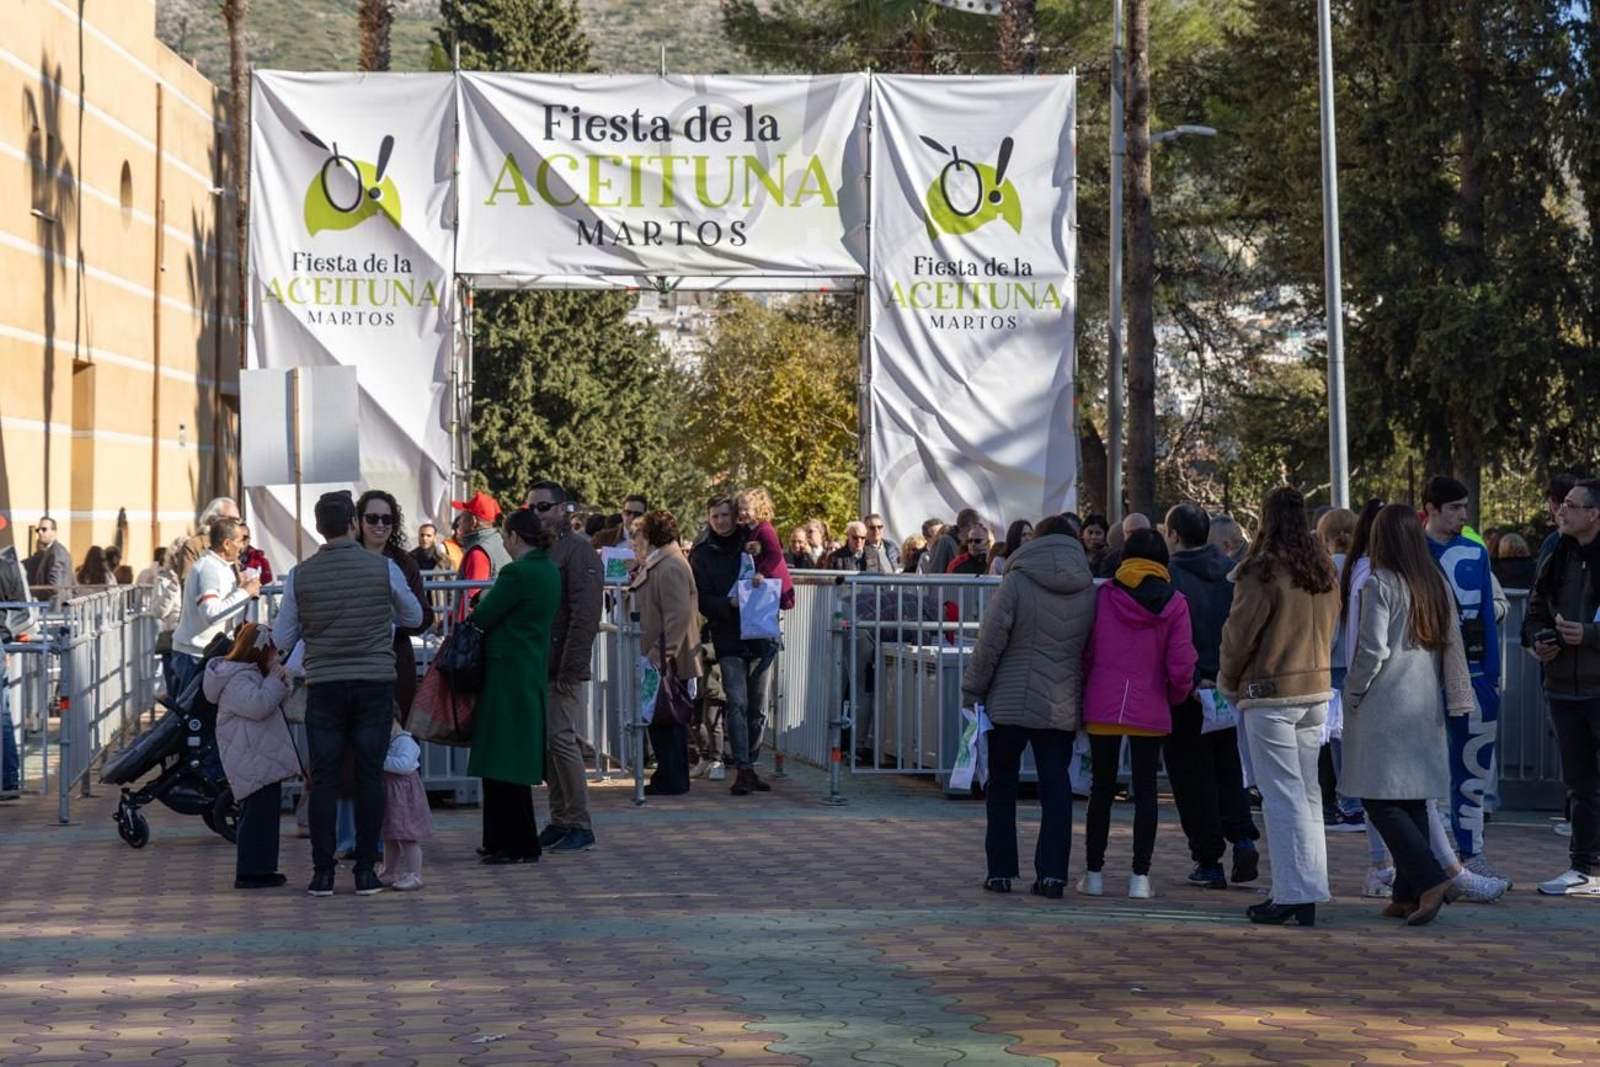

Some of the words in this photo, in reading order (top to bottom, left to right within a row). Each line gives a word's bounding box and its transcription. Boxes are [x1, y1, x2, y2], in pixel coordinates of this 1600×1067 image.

[543, 104, 672, 142] Fiesta
[684, 105, 732, 142] de
[744, 104, 780, 142] la
[484, 153, 839, 208] ACEITUNA
[577, 219, 747, 247] MARTOS
[292, 252, 357, 272] Fiesta
[363, 253, 388, 273] de
[393, 254, 412, 273] la
[913, 256, 978, 276] Fiesta
[984, 256, 1008, 277] de
[1013, 256, 1033, 276] la
[263, 276, 440, 308] ACEITUNA
[884, 280, 1062, 310] ACEITUNA
[306, 310, 395, 327] MARTOS
[929, 314, 1017, 330] MARTOS
